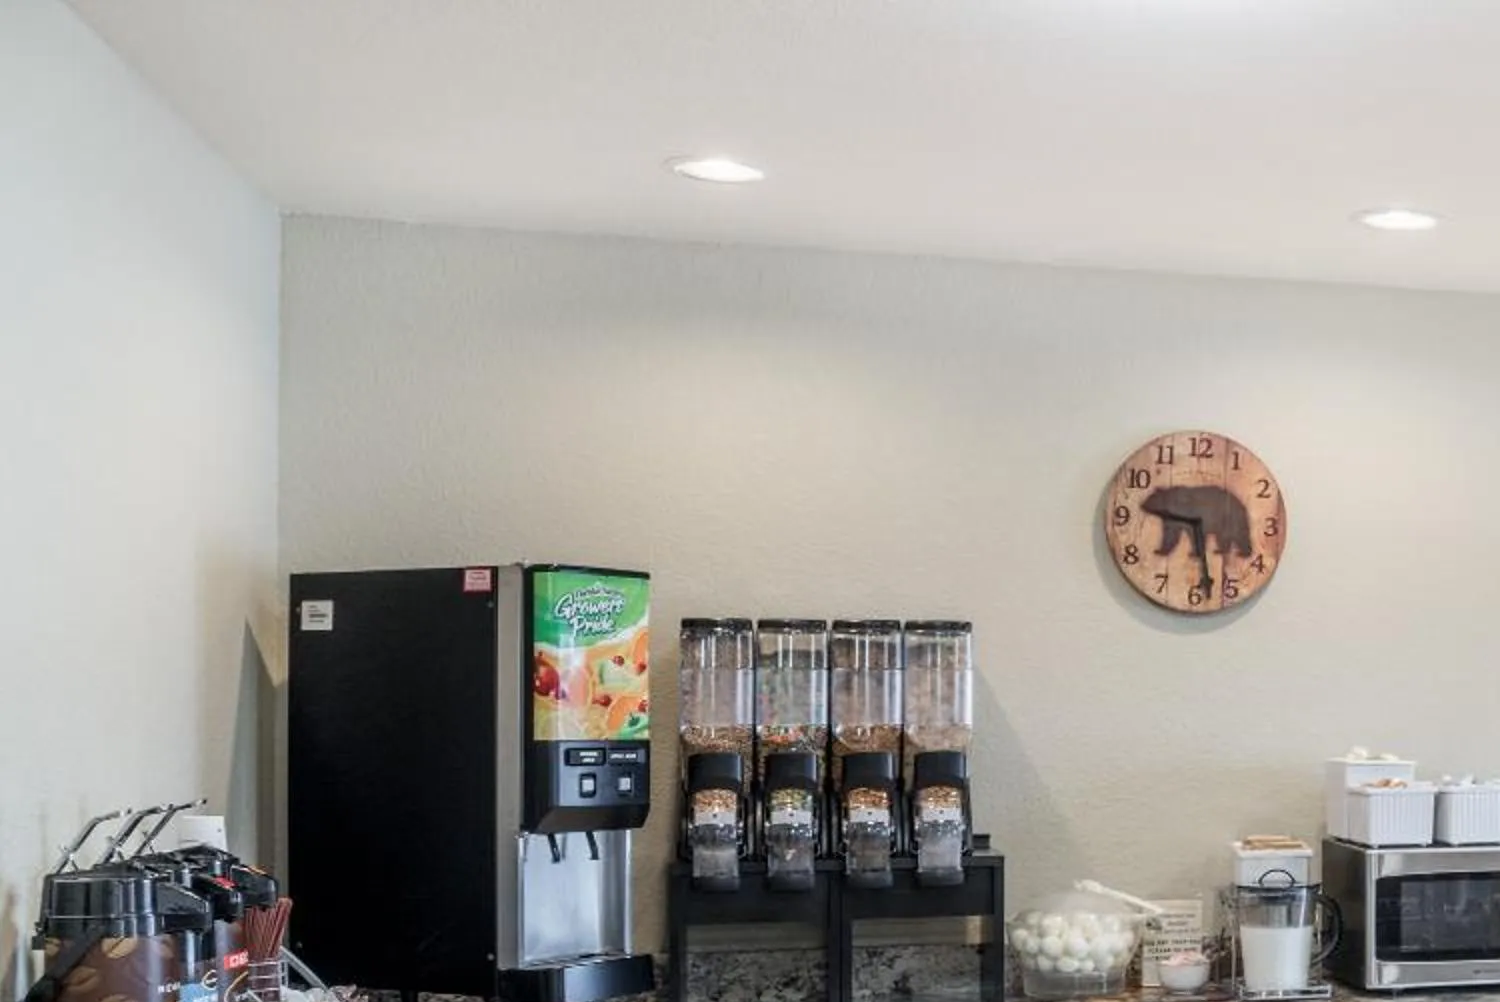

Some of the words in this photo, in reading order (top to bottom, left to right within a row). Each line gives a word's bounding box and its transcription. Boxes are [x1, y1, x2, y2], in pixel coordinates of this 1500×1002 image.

[1155, 444, 1175, 465] 11
[1188, 437, 1215, 459] 12
[1231, 451, 1241, 471] 1
[1127, 468, 1151, 489] 10
[1256, 479, 1271, 499] 2
[1114, 505, 1130, 526] 9
[1263, 517, 1278, 537] 3
[1123, 544, 1139, 565] 8
[1250, 553, 1265, 575] 4
[1155, 574, 1169, 594] 7
[1224, 579, 1239, 599] 5
[1187, 584, 1203, 606] 6
[569, 615, 616, 637] Pride
